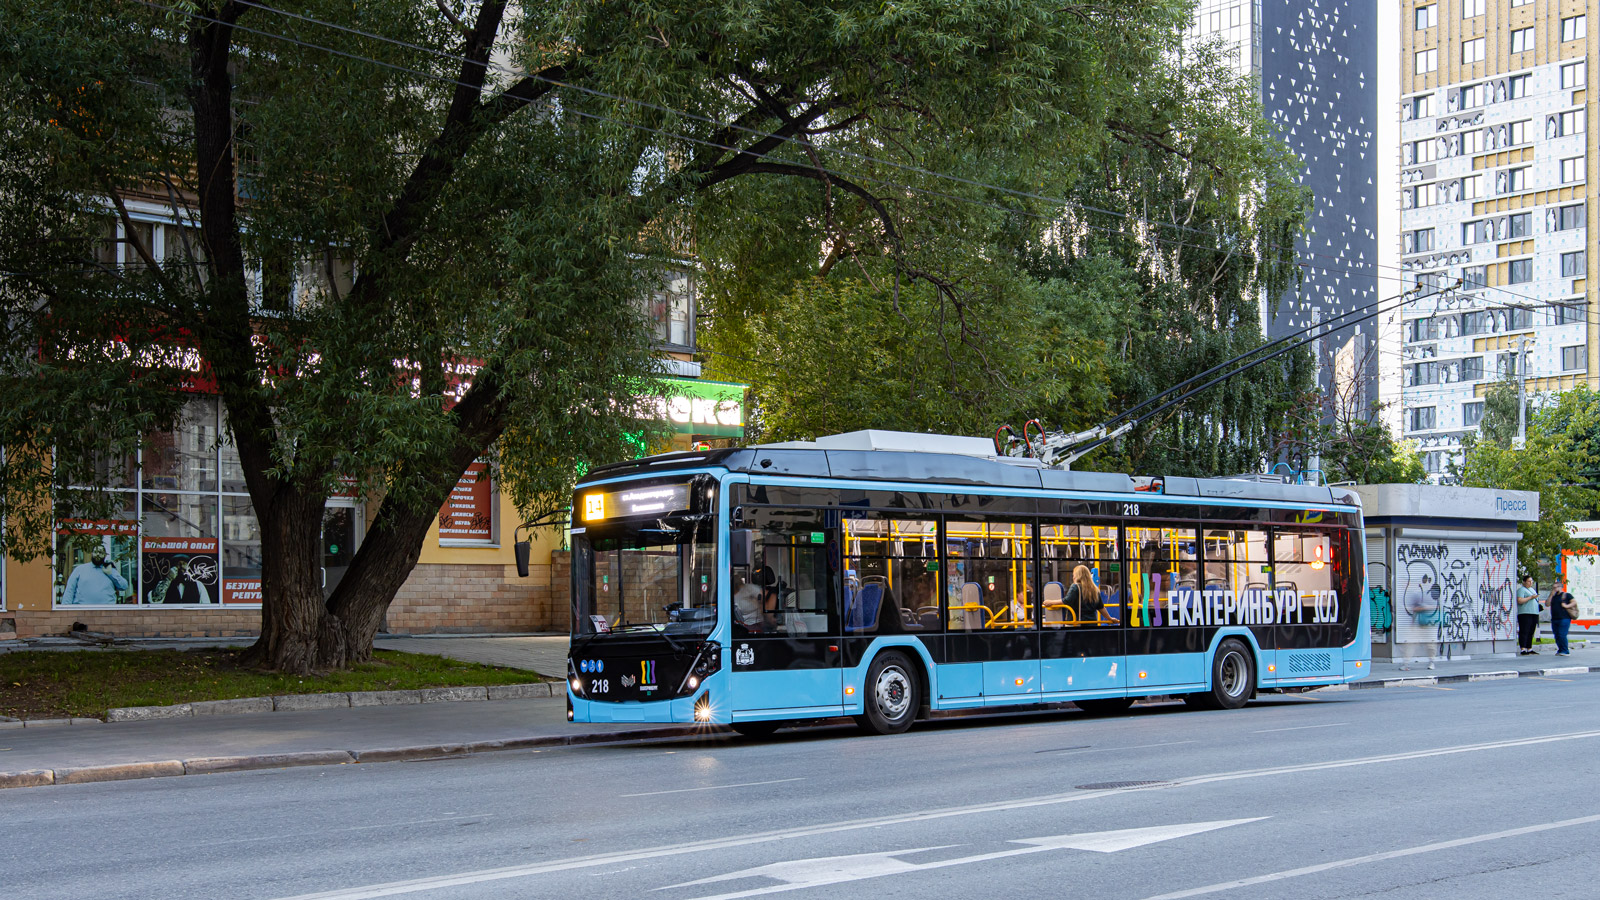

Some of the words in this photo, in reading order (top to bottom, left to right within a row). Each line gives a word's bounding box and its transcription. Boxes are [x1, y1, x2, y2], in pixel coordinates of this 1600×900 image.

[1124, 504, 1139, 516] 218
[1496, 497, 1527, 514] Пресса
[190, 542, 216, 550] ОПЫТ
[225, 582, 262, 590] БЕЗУПР
[232, 591, 263, 599] РЕПУТ
[1168, 590, 1303, 626] ЕКАТЕРИНБУРГ
[592, 679, 609, 693] 218
